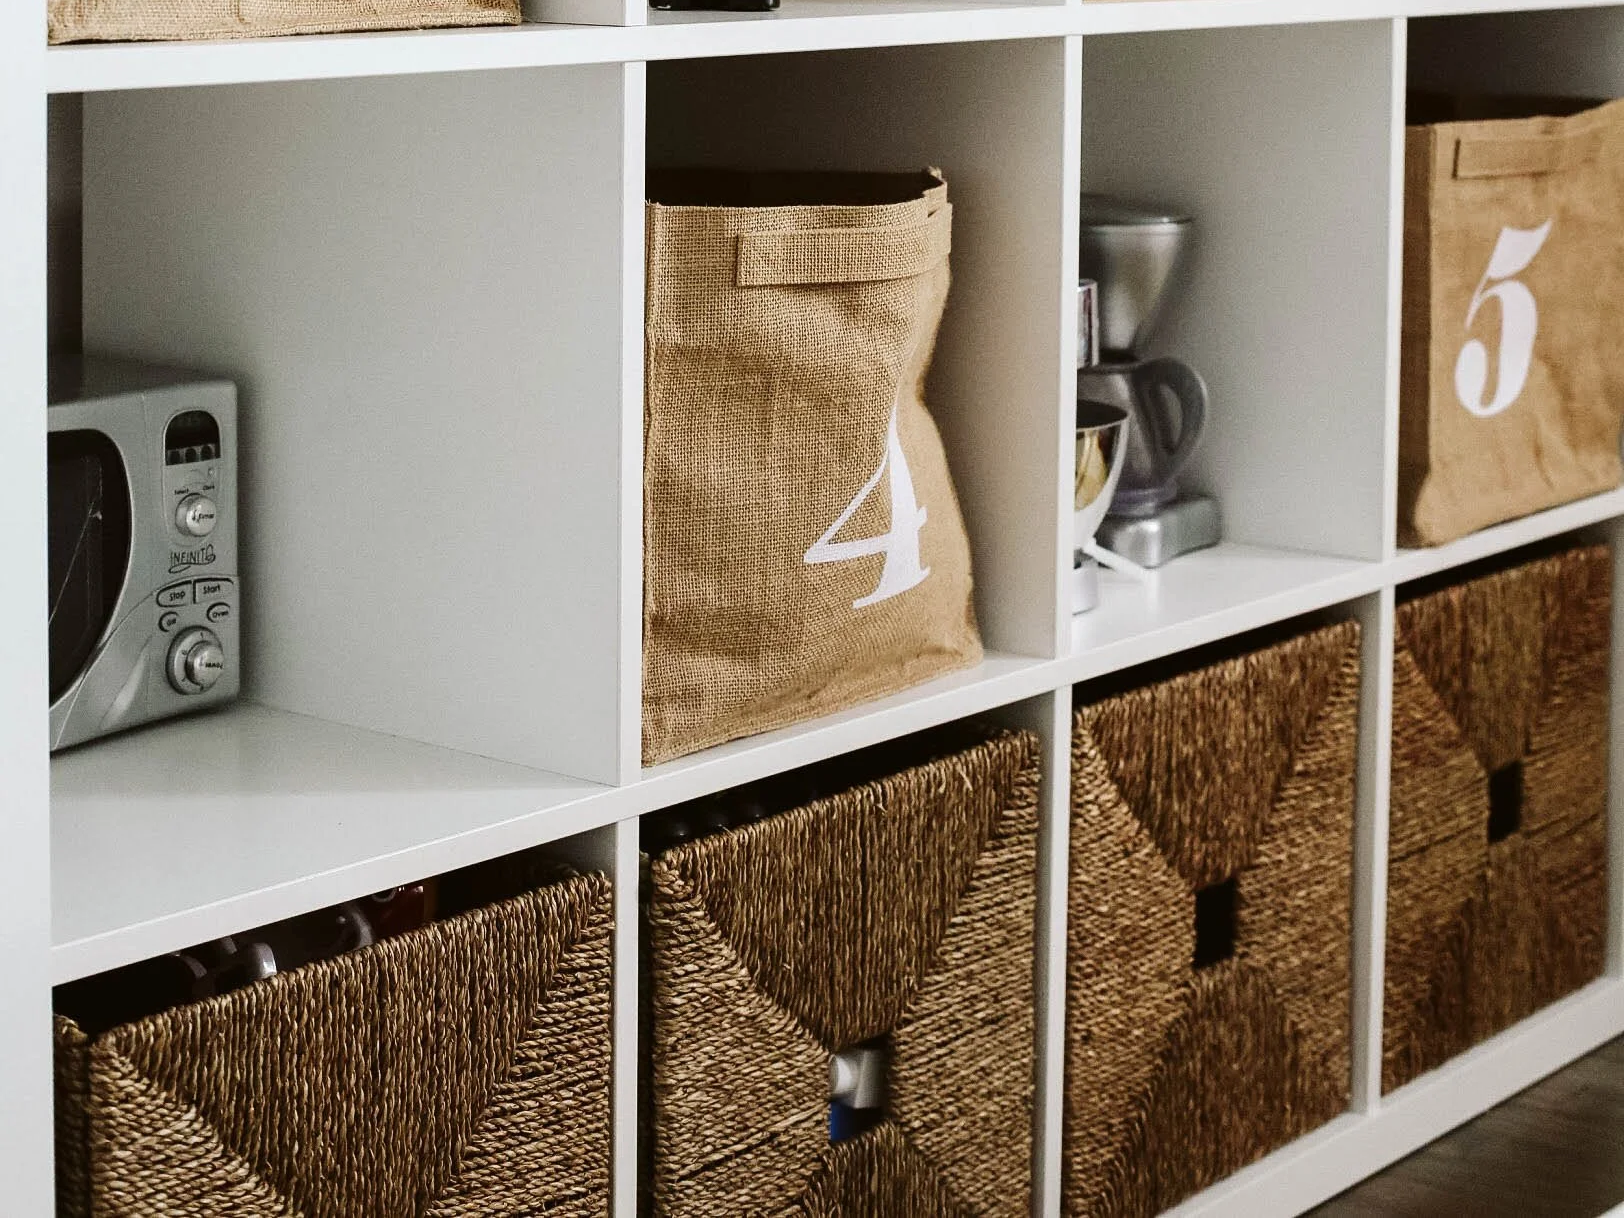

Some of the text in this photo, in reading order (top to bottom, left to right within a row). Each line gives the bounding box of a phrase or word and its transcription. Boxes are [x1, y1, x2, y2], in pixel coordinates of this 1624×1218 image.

[1455, 218, 1553, 418] 5
[803, 397, 931, 609] 4
[169, 591, 186, 601] Stop
[203, 584, 221, 594] Start
